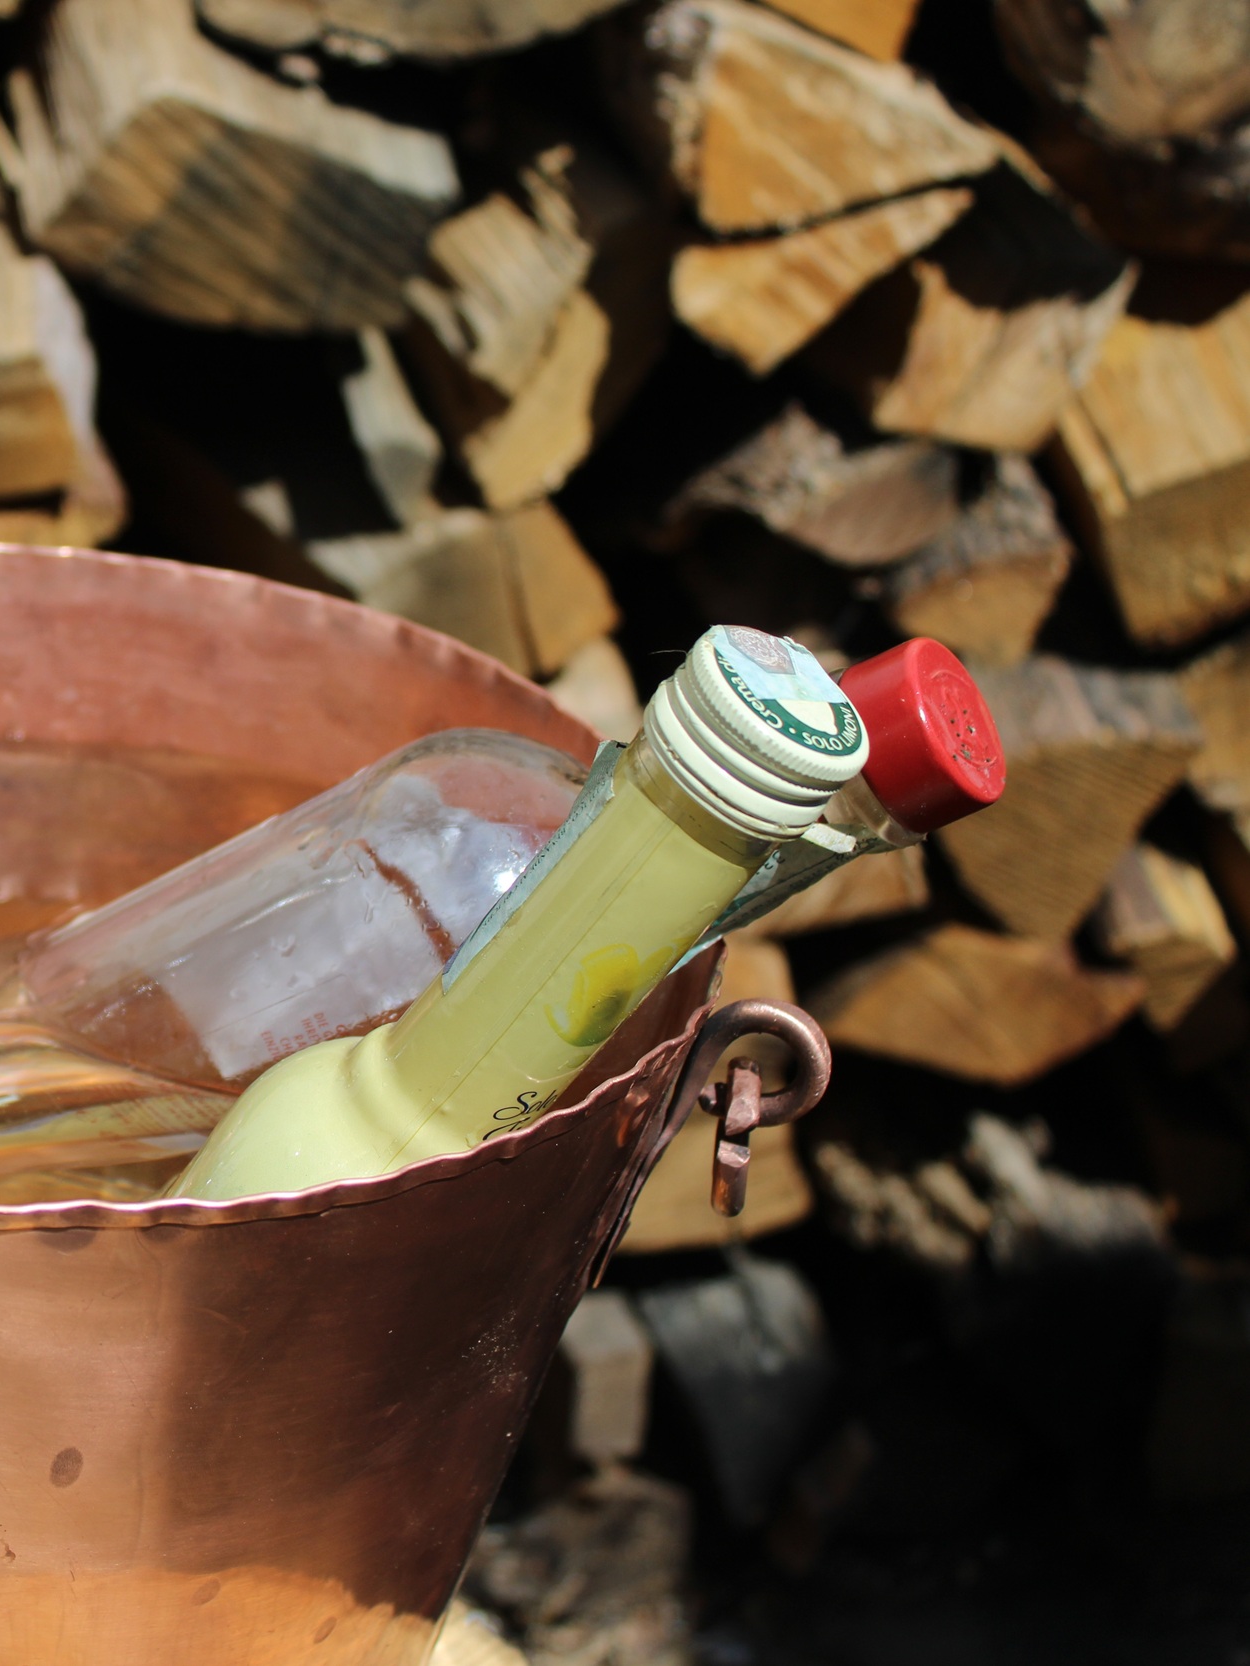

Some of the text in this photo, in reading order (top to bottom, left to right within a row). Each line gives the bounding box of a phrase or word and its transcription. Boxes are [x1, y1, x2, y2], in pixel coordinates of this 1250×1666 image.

[730, 676, 784, 730] Crema
[801, 705, 858, 751] SOLO LIMONI
